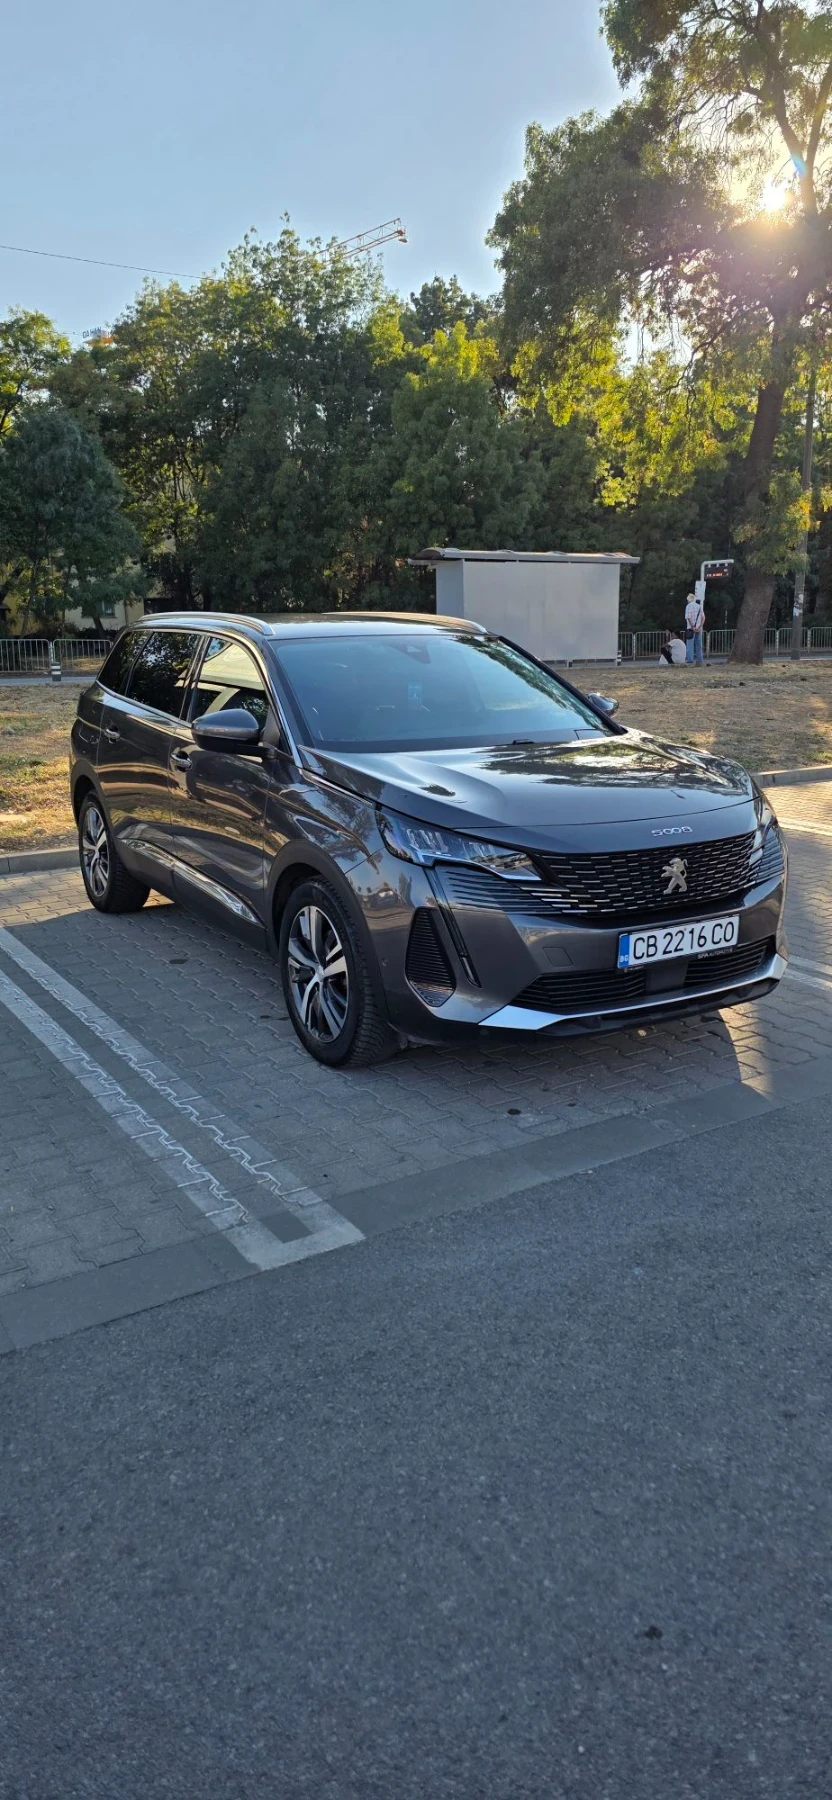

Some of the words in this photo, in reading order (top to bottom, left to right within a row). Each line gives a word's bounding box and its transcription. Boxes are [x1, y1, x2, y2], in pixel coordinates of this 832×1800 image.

[633, 935, 658, 960] CB
[662, 926, 707, 955] 2216
[711, 921, 735, 945] CO
[620, 954, 629, 963] BG
